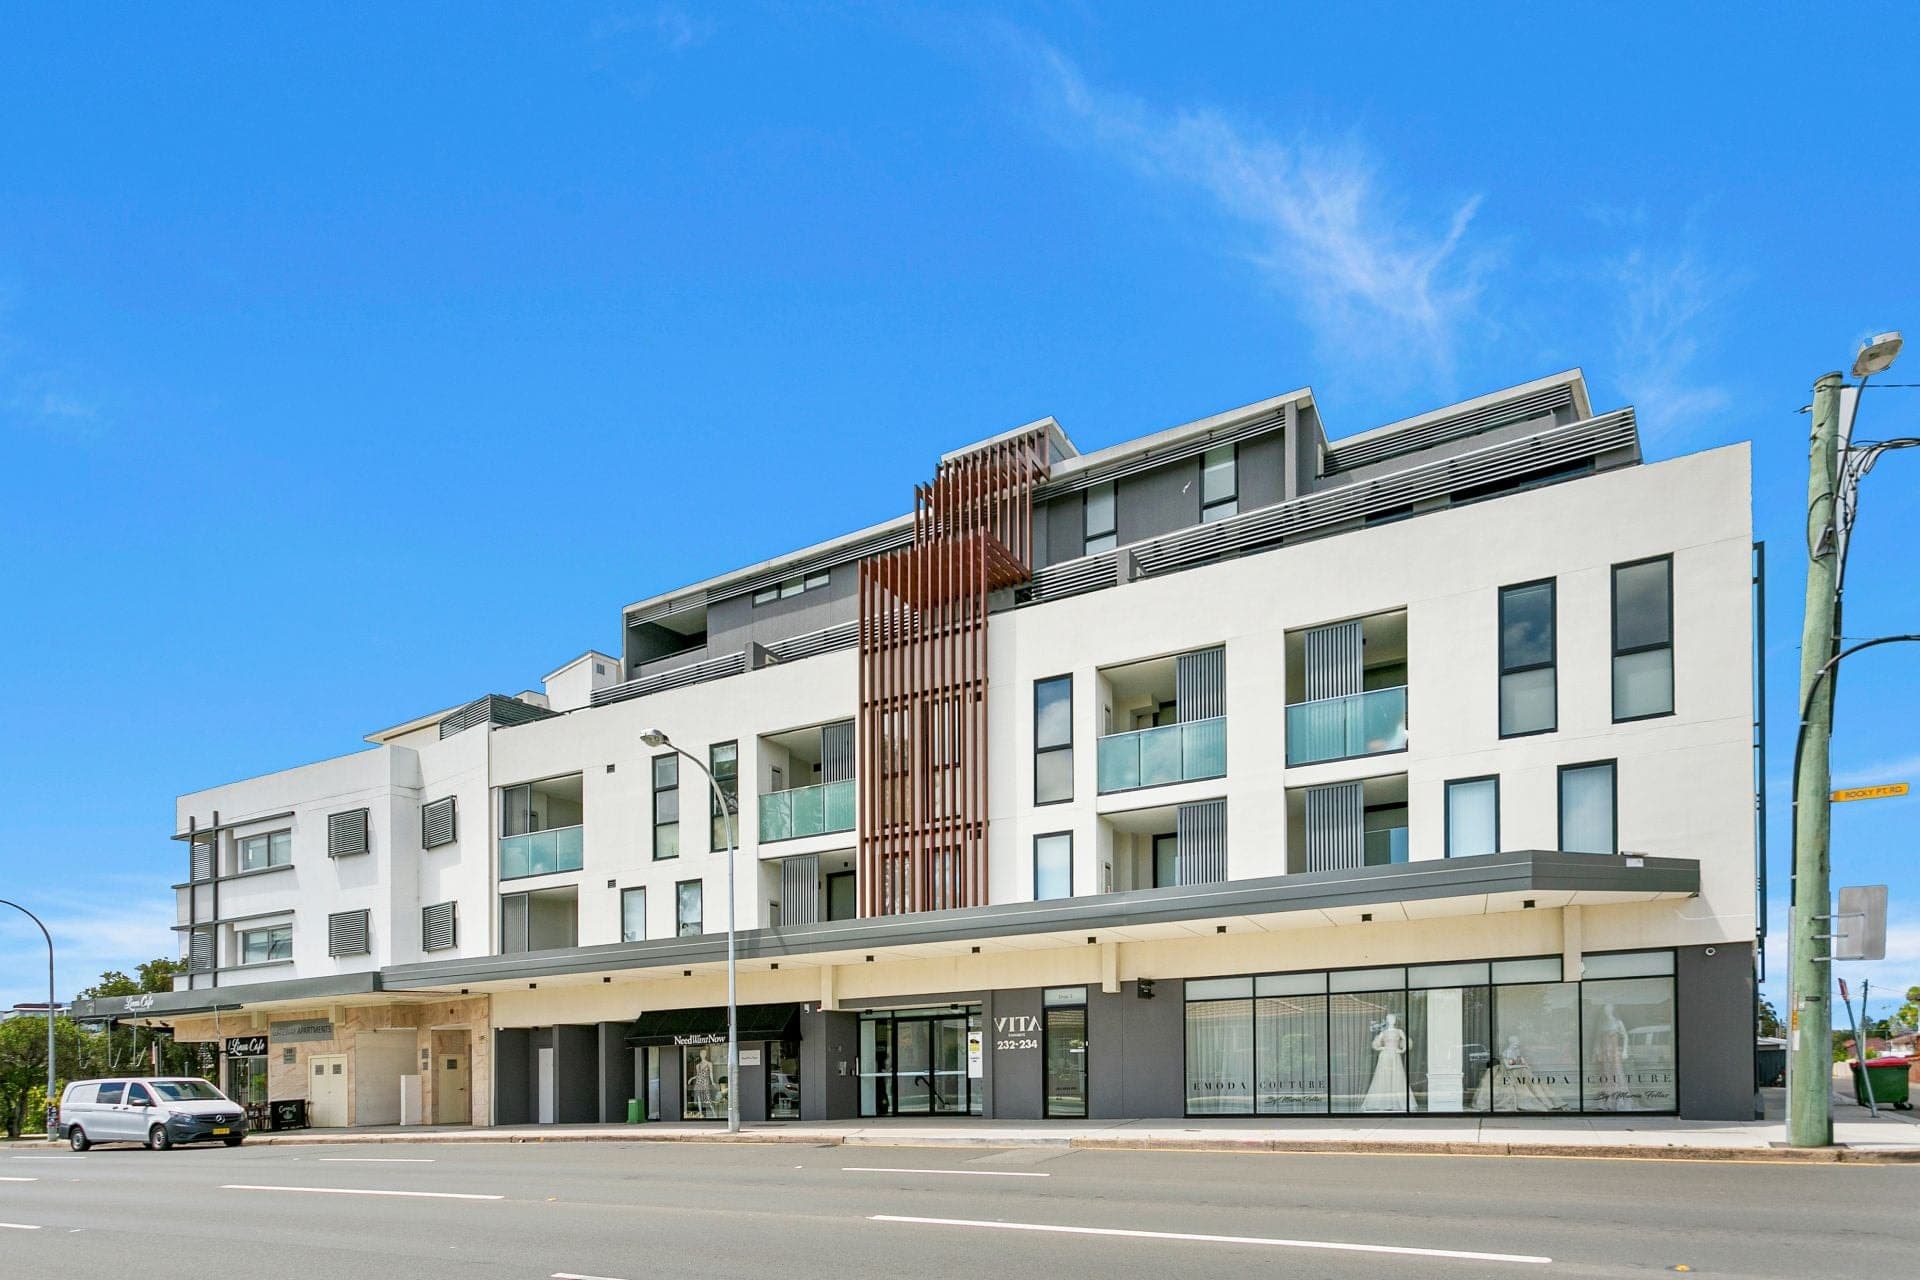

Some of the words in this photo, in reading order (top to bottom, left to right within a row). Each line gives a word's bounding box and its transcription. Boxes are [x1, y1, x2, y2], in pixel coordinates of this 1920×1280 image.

[1845, 788, 1873, 799] ROCKY
[993, 1016, 1042, 1032] VITA
[249, 1038, 265, 1054] Cafe
[997, 1040, 1038, 1049] 232-234
[1194, 1080, 1246, 1091] EMODA
[1259, 1080, 1325, 1089] COUTURE
[1503, 1075, 1570, 1086] EMODA
[1587, 1073, 1673, 1085] COUTURE
